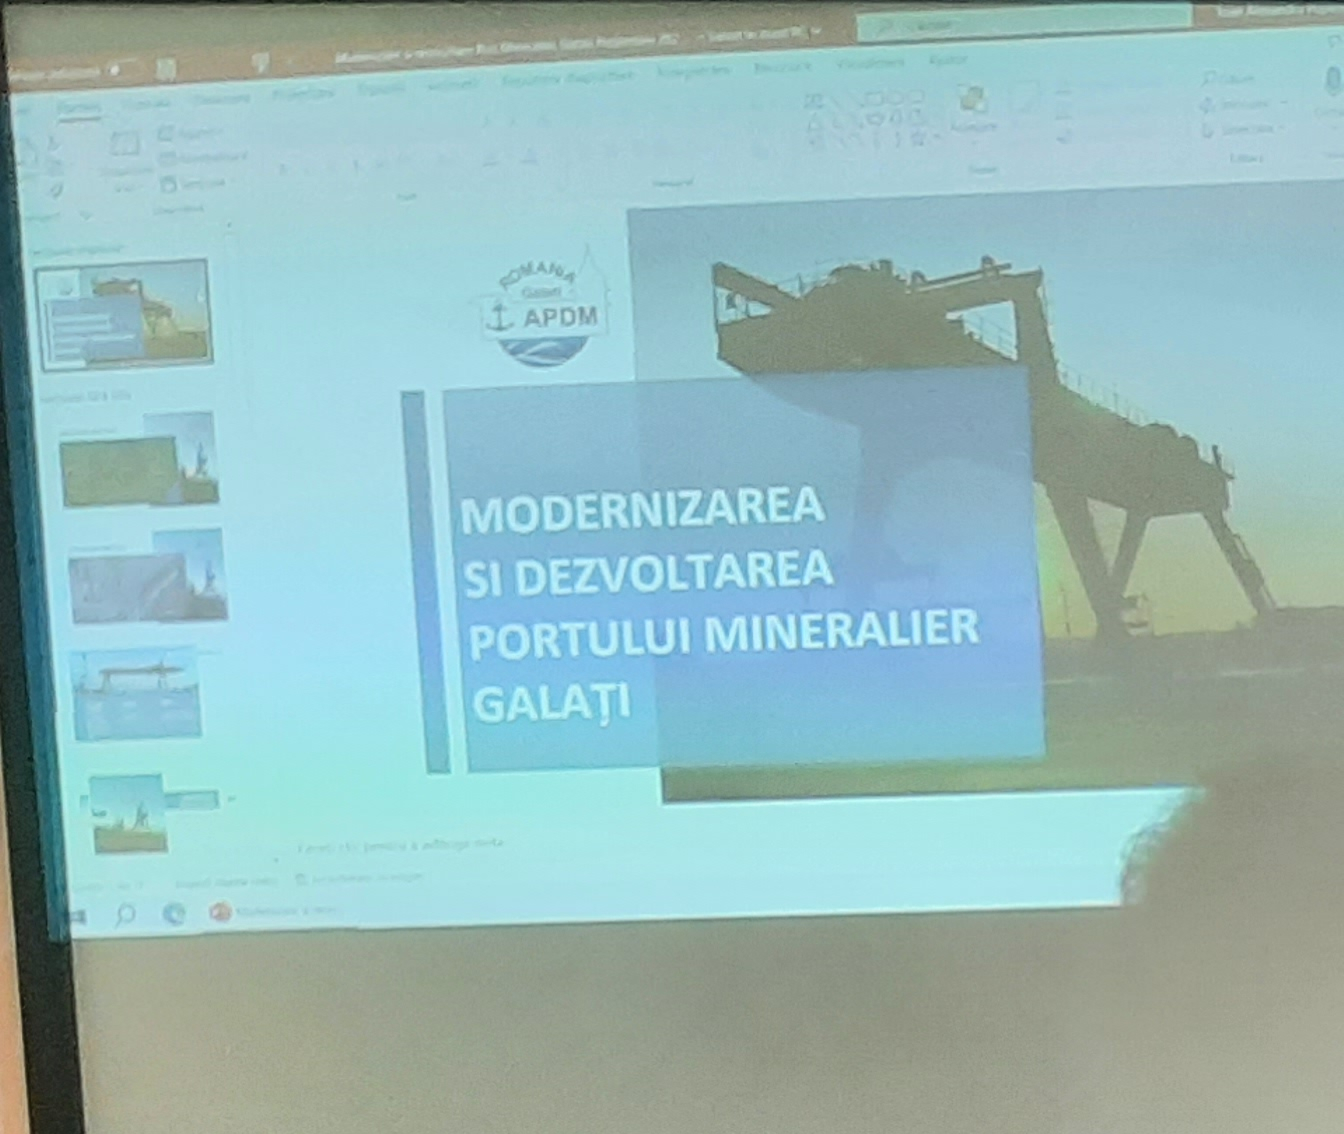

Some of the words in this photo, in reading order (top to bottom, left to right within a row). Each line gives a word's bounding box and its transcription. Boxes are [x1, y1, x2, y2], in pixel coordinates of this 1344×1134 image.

[524, 305, 598, 327] APDM
[461, 484, 826, 535] MODERNIZAREA
[465, 562, 502, 599] SI
[516, 549, 834, 598] DEZVOLTAREA
[470, 616, 691, 661] PORTULUI
[705, 607, 980, 653] MINERALIER
[473, 681, 631, 727] GALAȚI
